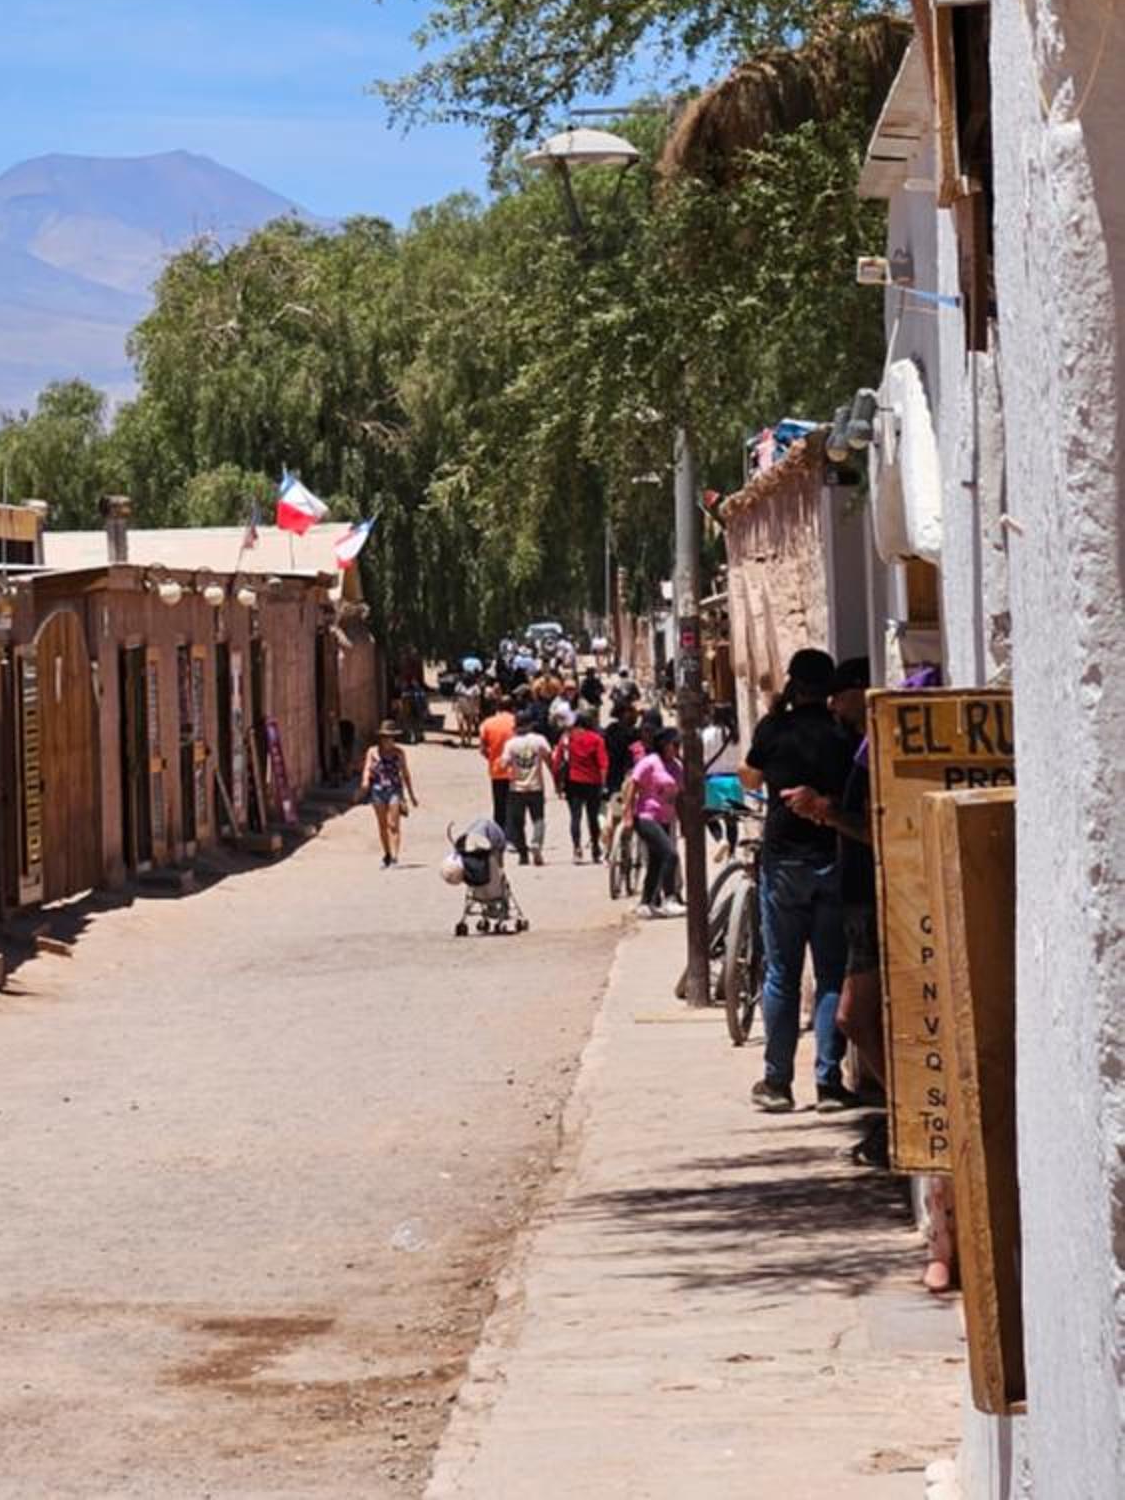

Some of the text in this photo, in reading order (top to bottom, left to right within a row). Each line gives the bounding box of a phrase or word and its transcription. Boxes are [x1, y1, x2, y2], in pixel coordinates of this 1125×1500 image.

[897, 705, 952, 754] EL
[923, 983, 937, 1000] N
[924, 1016, 940, 1036] V
